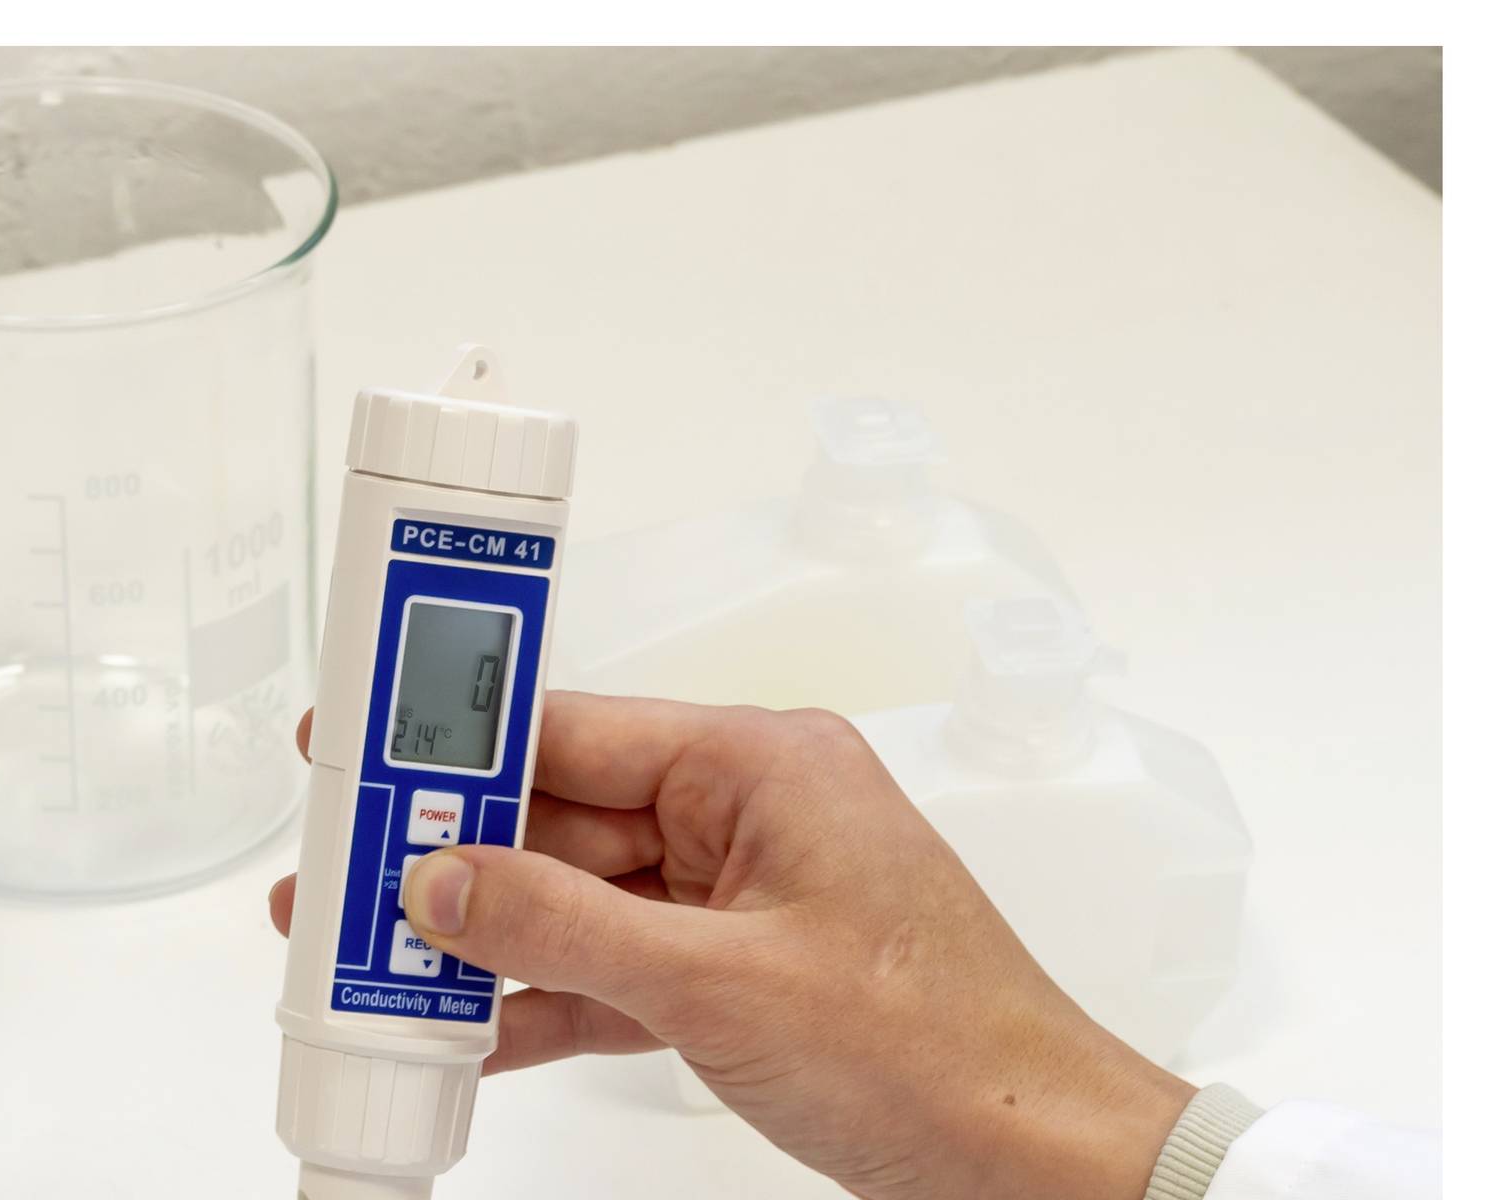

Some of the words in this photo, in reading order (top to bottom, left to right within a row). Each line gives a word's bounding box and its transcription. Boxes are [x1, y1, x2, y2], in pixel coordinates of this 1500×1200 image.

[84, 472, 141, 500] 800
[204, 510, 285, 577] 1000
[402, 524, 506, 557] PCE-CM
[513, 540, 542, 561] 41
[87, 579, 146, 607] 600
[91, 685, 149, 710] 400
[470, 654, 501, 713] 0
[419, 808, 457, 823] POWER
[340, 986, 433, 1016] Conductivity
[438, 995, 480, 1016] Meter
